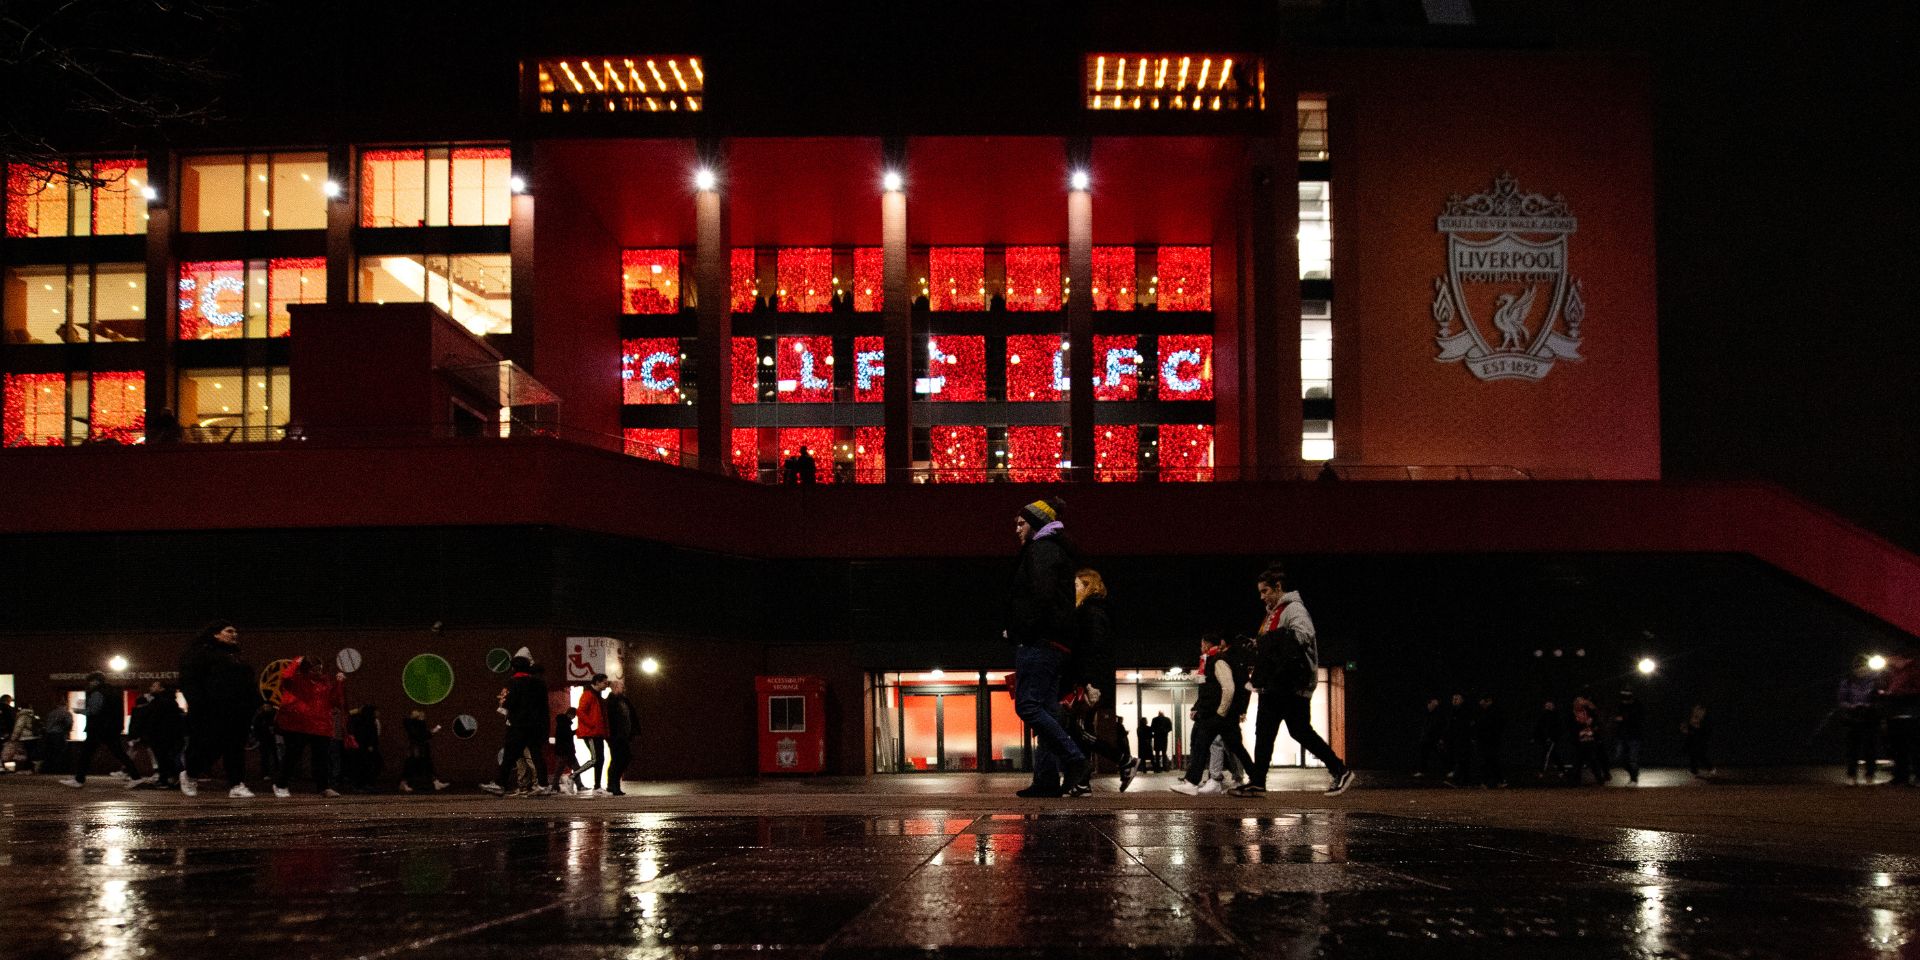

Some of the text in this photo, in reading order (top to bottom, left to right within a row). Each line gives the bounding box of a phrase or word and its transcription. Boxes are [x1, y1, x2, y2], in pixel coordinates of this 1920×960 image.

[1475, 218, 1508, 229] NEVER
[1459, 250, 1560, 269] LIVERPOOL
[1462, 271, 1522, 283] FOOTBALL
